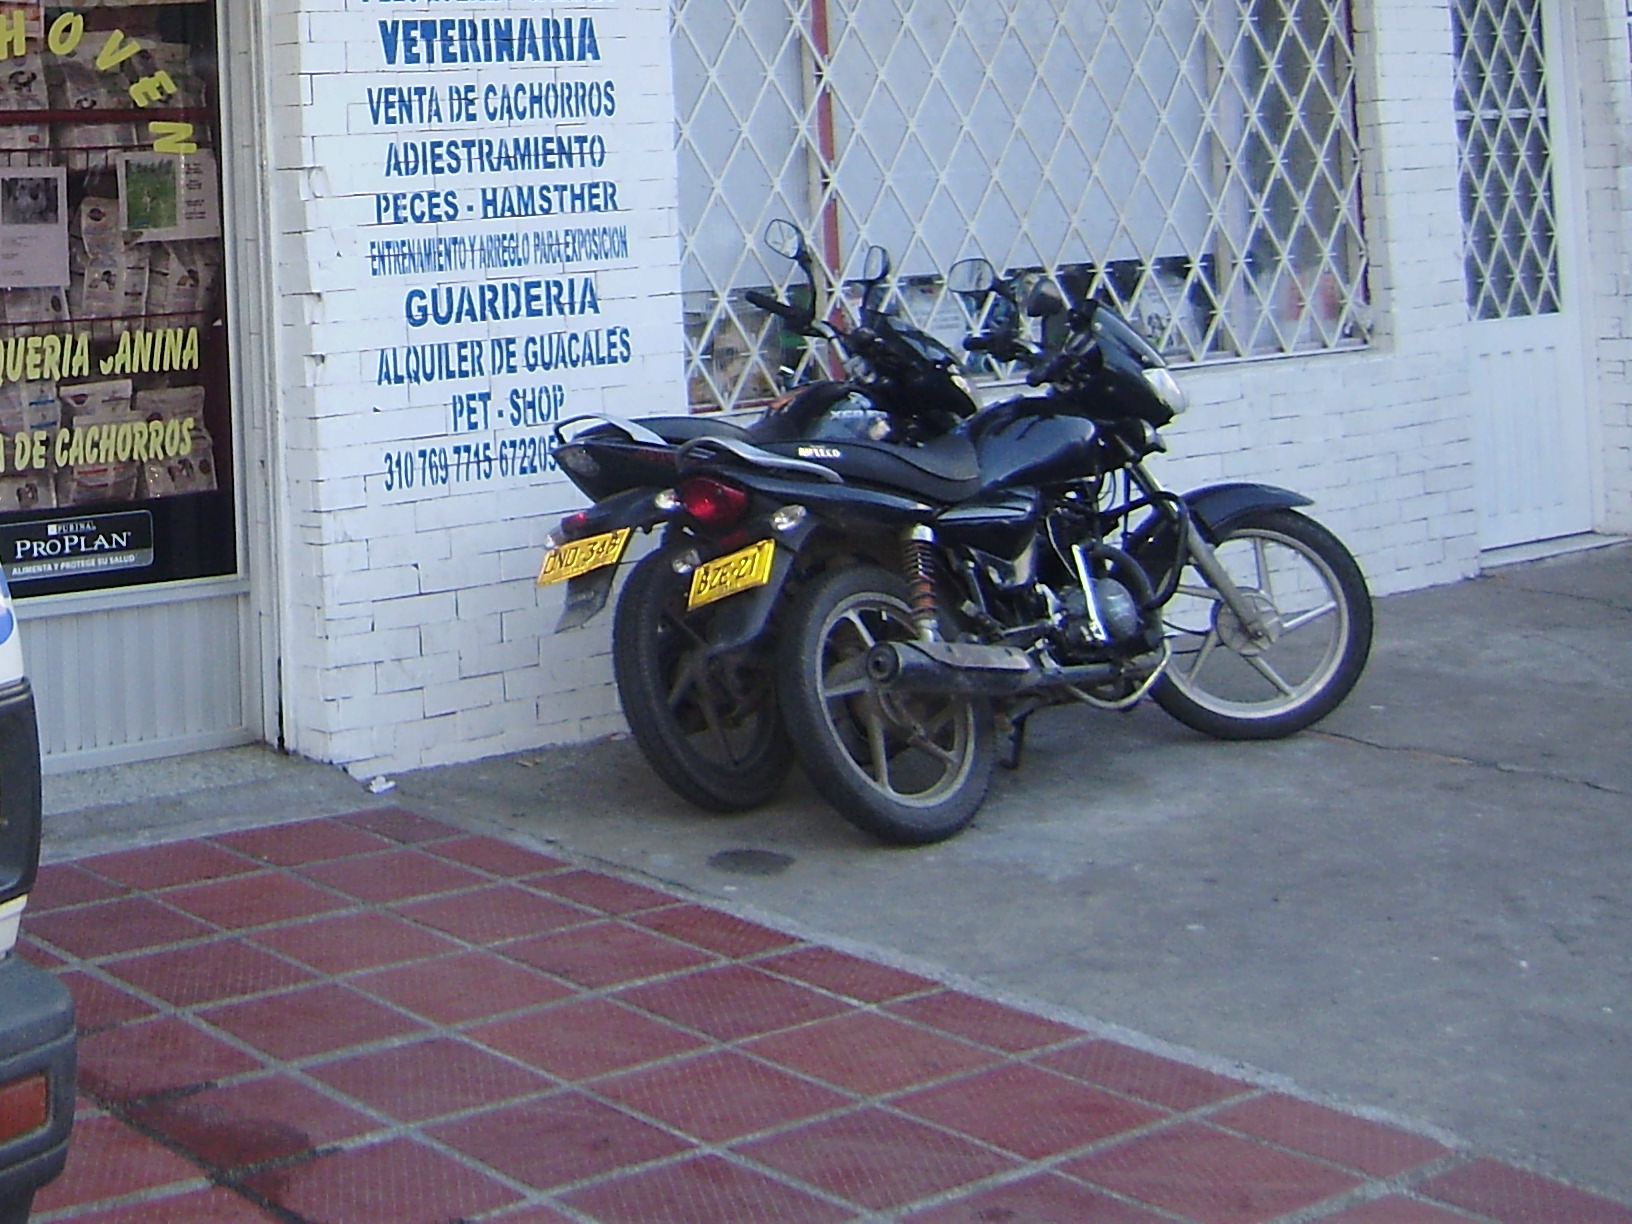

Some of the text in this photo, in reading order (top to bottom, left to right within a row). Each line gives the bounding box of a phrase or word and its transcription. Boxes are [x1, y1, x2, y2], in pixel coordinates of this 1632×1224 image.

[378, 17, 602, 65] VETERINARIA
[367, 79, 617, 126] VENTA DE CACHORROS
[384, 134, 606, 177] ADIESTRAMIENTO
[375, 189, 460, 225] PECES
[480, 181, 618, 219] HAMSTHER
[369, 224, 629, 276] ENTRENAMIENTO Y ARREGLO PARA EXPOSICION
[404, 277, 601, 328] GUARDERIA
[376, 327, 632, 386] ALQUILER DE GUACALES
[451, 390, 492, 433] PET
[509, 384, 565, 427] SHOP
[14, 431, 48, 472] DE
[54, 416, 196, 468] CACHORROS
[384, 450, 414, 492] 310
[418, 446, 449, 488] 769
[452, 441, 493, 483] 7715
